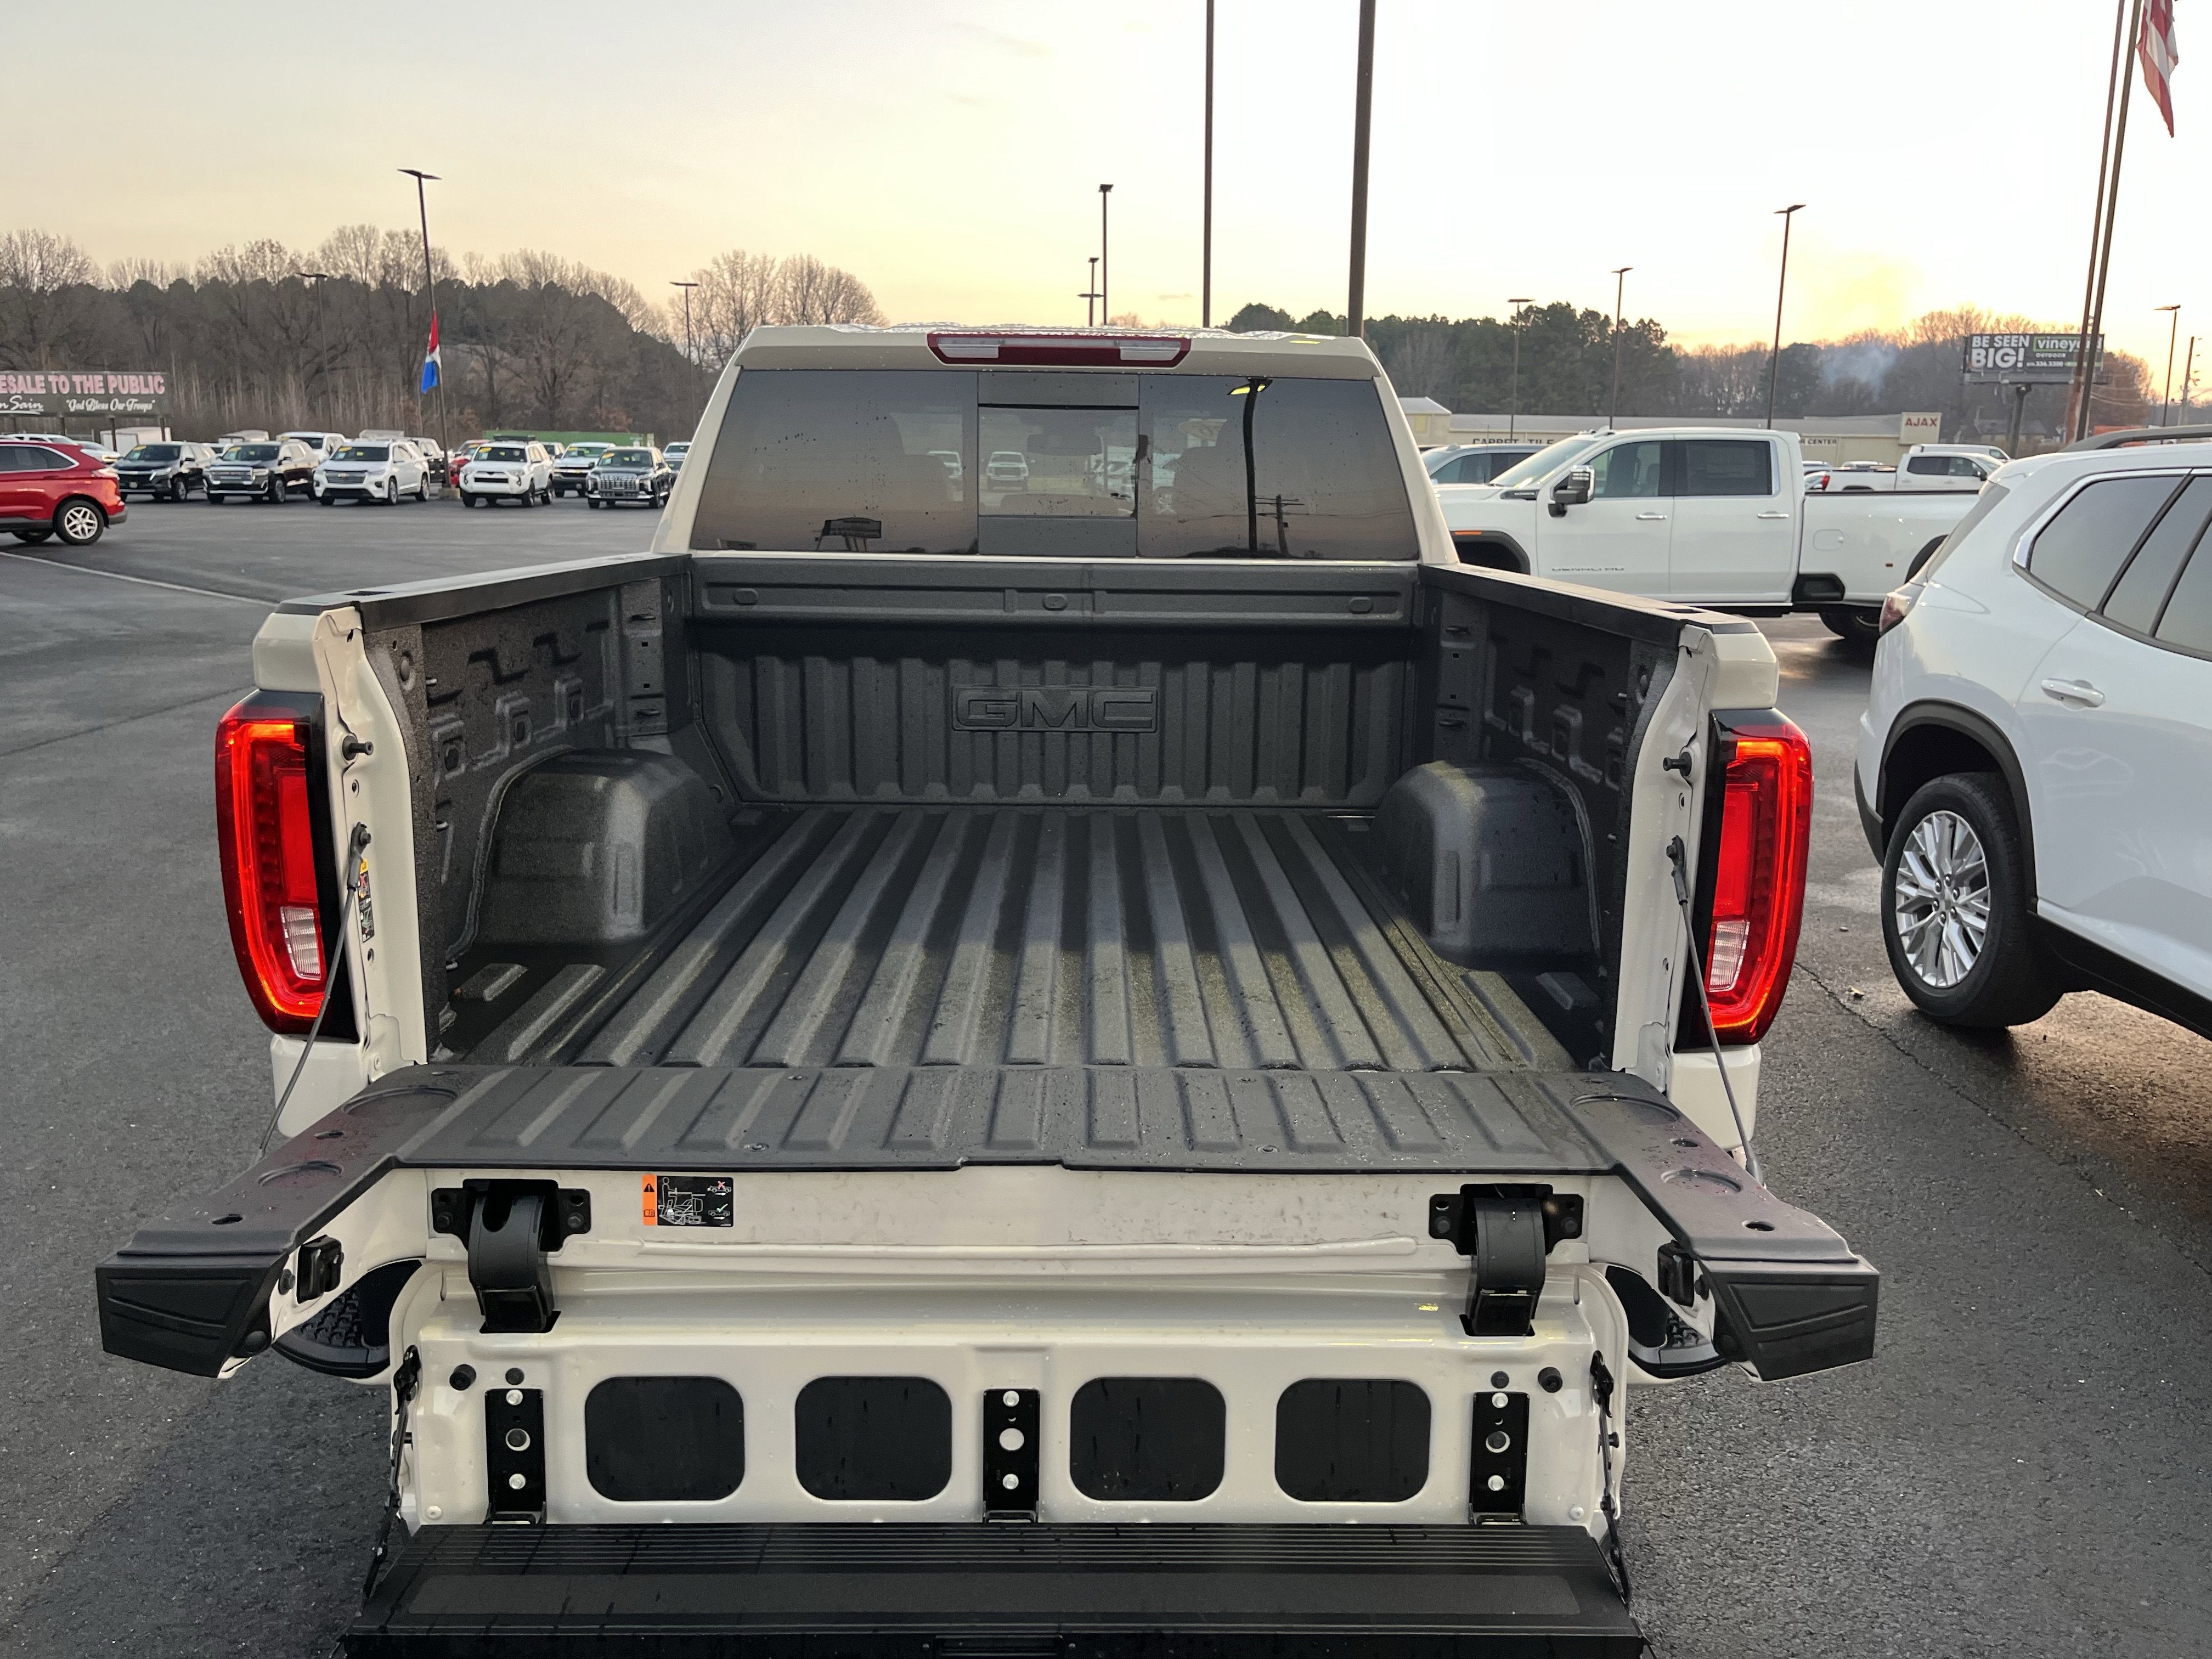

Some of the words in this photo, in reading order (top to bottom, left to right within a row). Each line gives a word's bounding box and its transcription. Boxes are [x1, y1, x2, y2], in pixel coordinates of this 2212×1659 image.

[1972, 335, 1989, 347] BE
[1993, 335, 2030, 348] SEEN
[2037, 336, 2103, 352] viney
[1971, 348, 2025, 368] BIG!
[48, 375, 70, 394] TO
[72, 375, 105, 394] THE
[108, 375, 165, 394] PUBLIC
[1905, 417, 1938, 426] AJAX
[956, 691, 1153, 727] GMC
